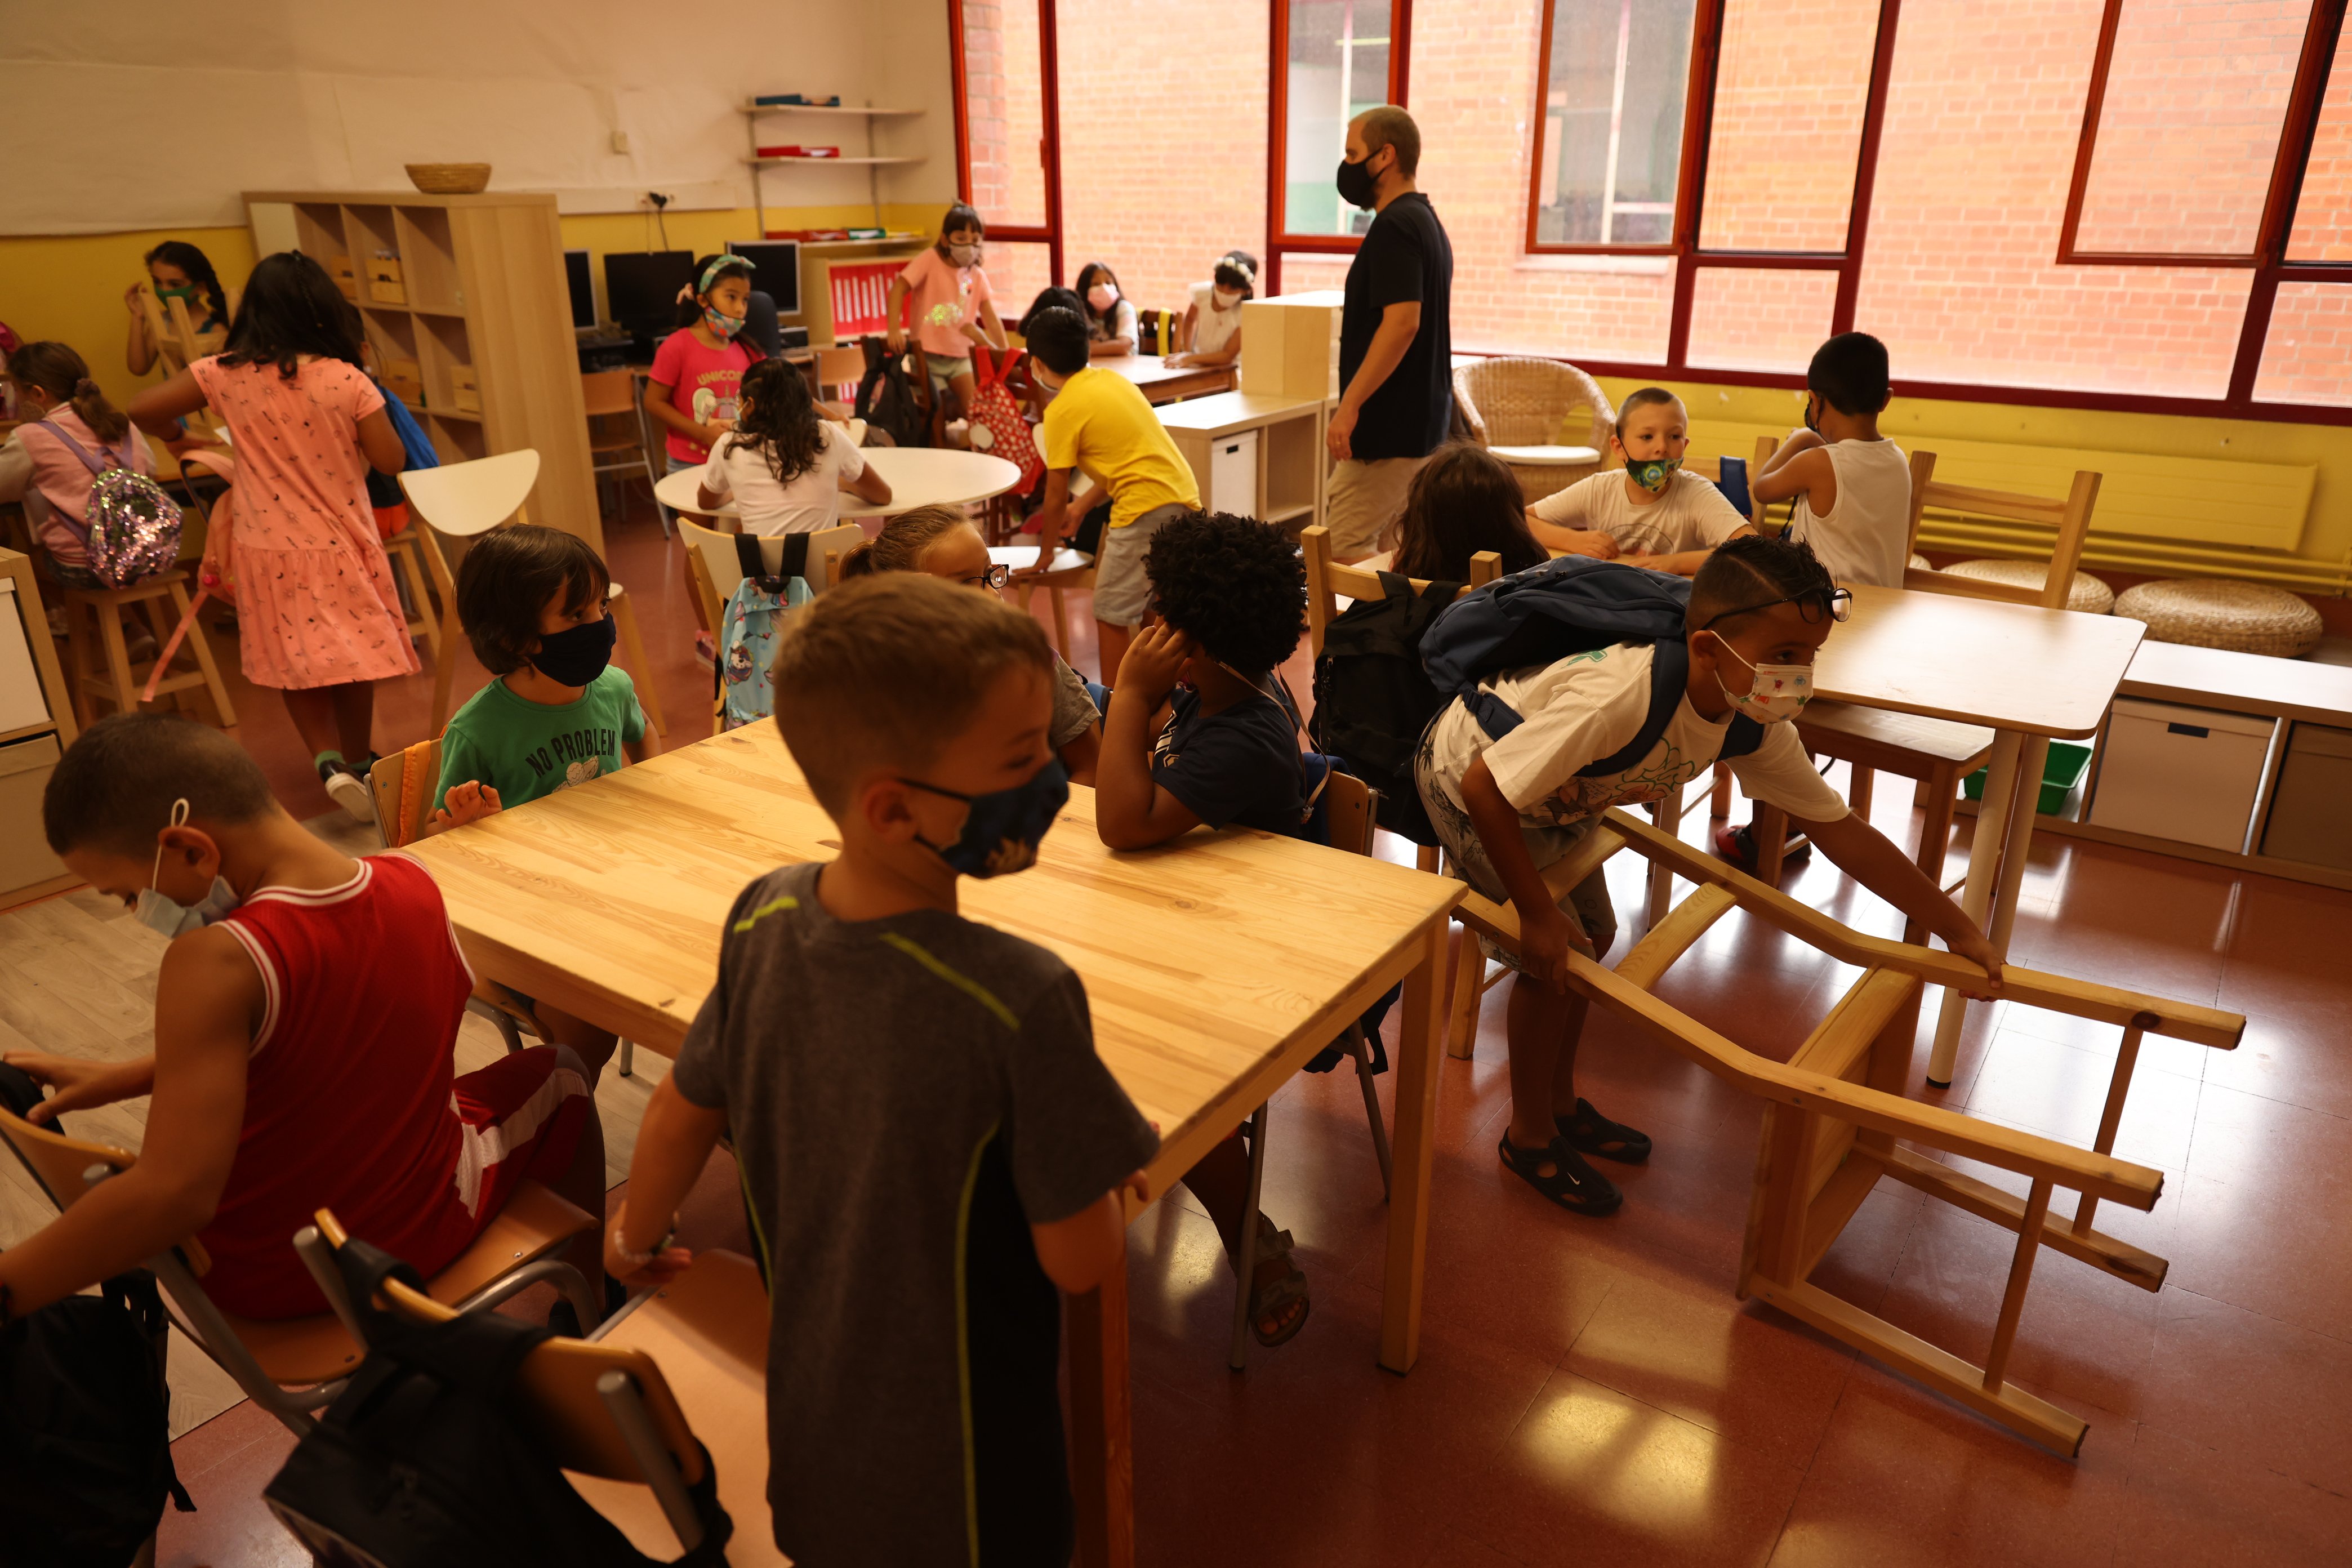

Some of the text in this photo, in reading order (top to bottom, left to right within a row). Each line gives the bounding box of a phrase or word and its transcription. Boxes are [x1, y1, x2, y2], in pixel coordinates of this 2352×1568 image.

[697, 369, 742, 385] UNICOR
[525, 729, 615, 778] NO PROBLEM
